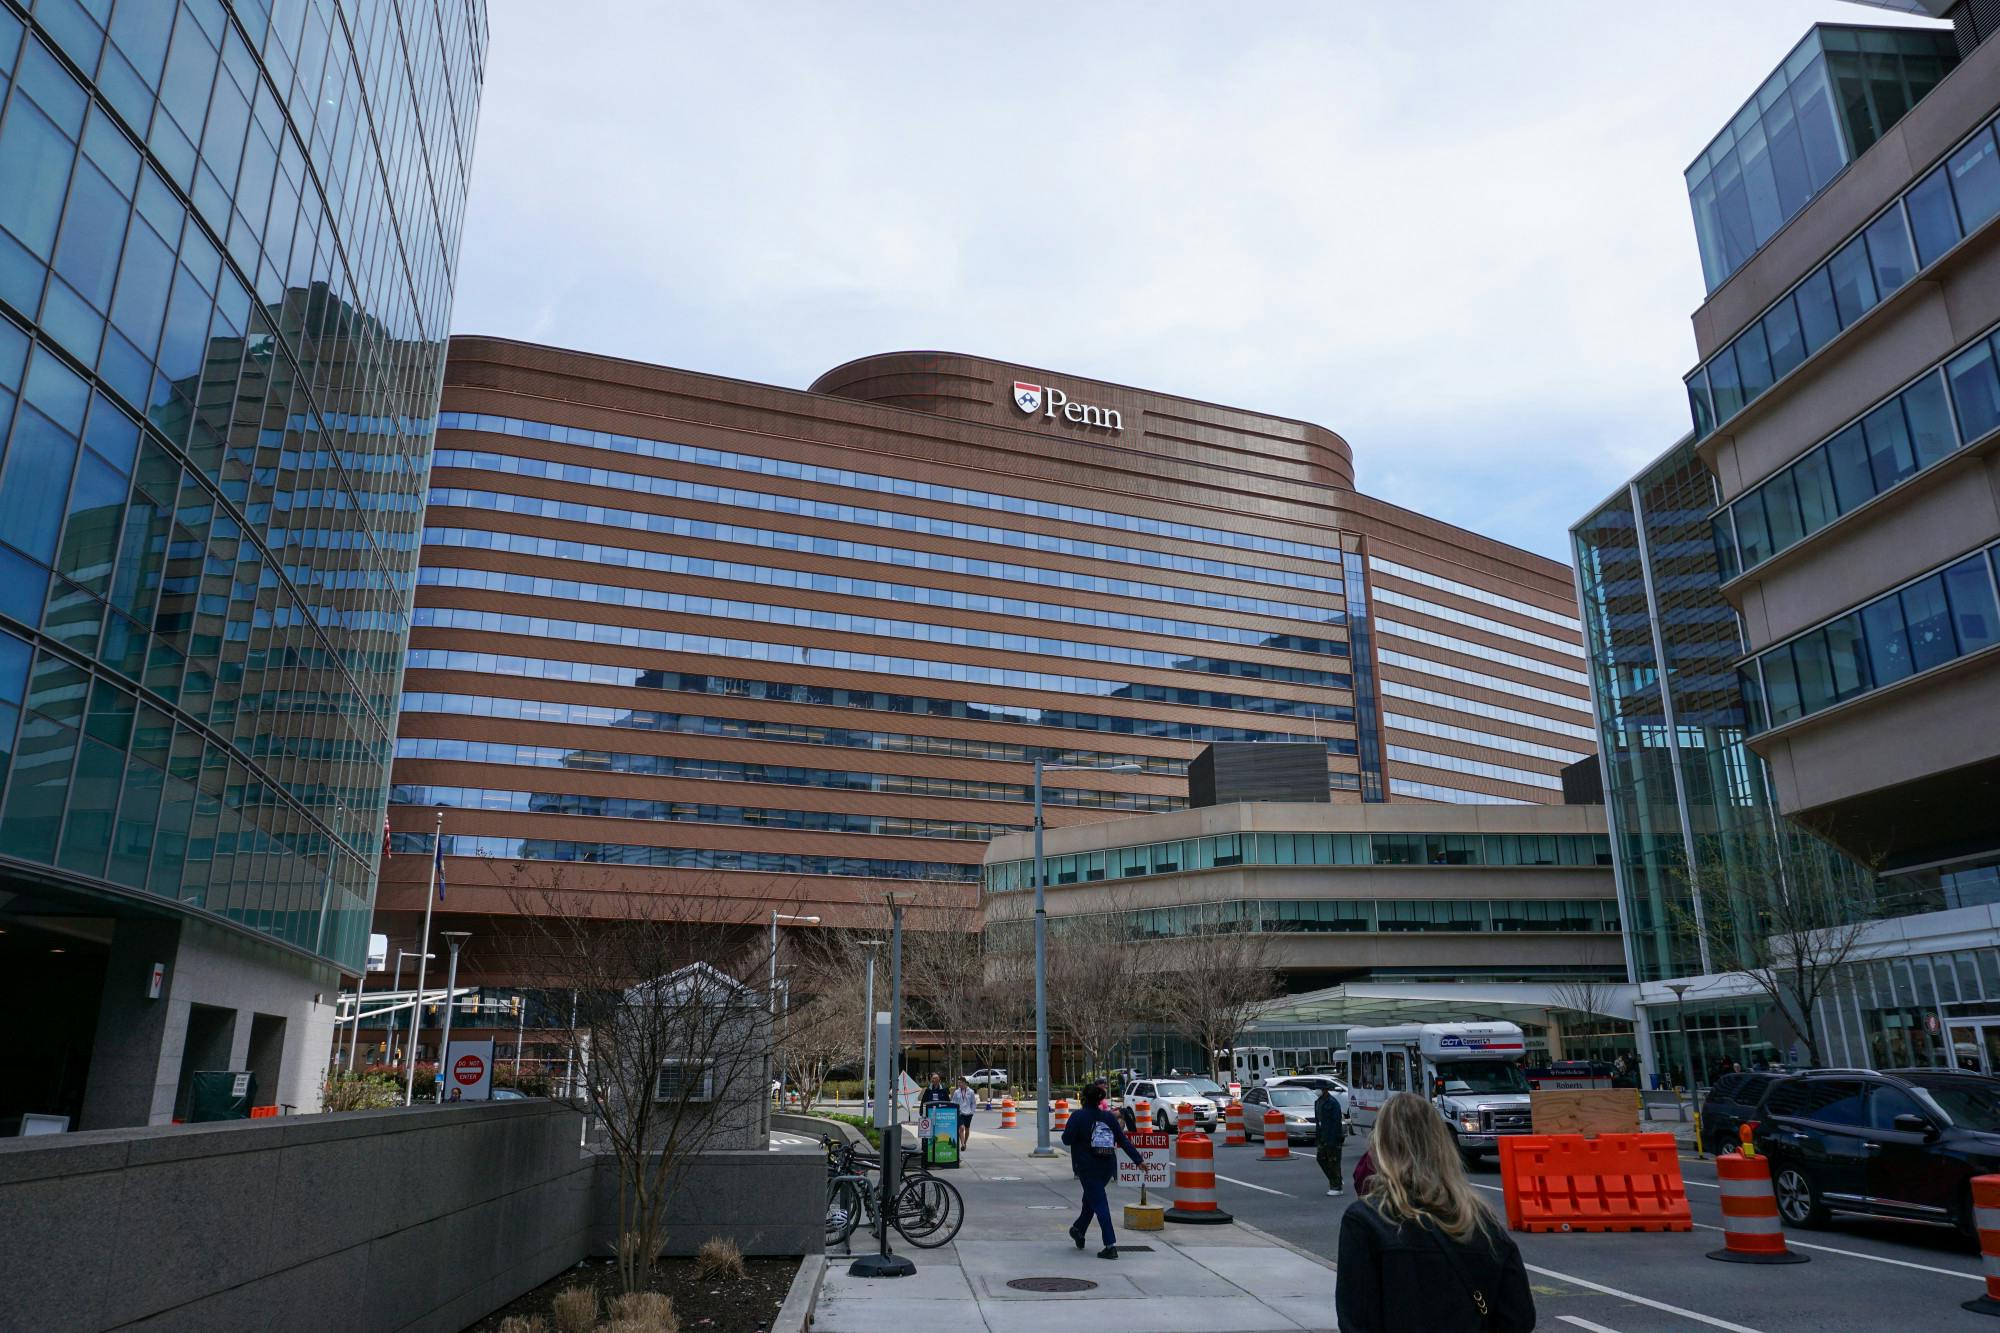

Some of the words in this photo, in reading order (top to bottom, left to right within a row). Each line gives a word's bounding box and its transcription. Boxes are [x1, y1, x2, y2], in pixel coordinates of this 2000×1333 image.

[1044, 386, 1124, 430] Penn
[1441, 1038, 1459, 1046] CCT
[1131, 1135, 1144, 1146] NOT
[1145, 1135, 1167, 1146] ENTER
[1121, 1174, 1140, 1182] NEXT
[1144, 1174, 1166, 1183] RIGHT
